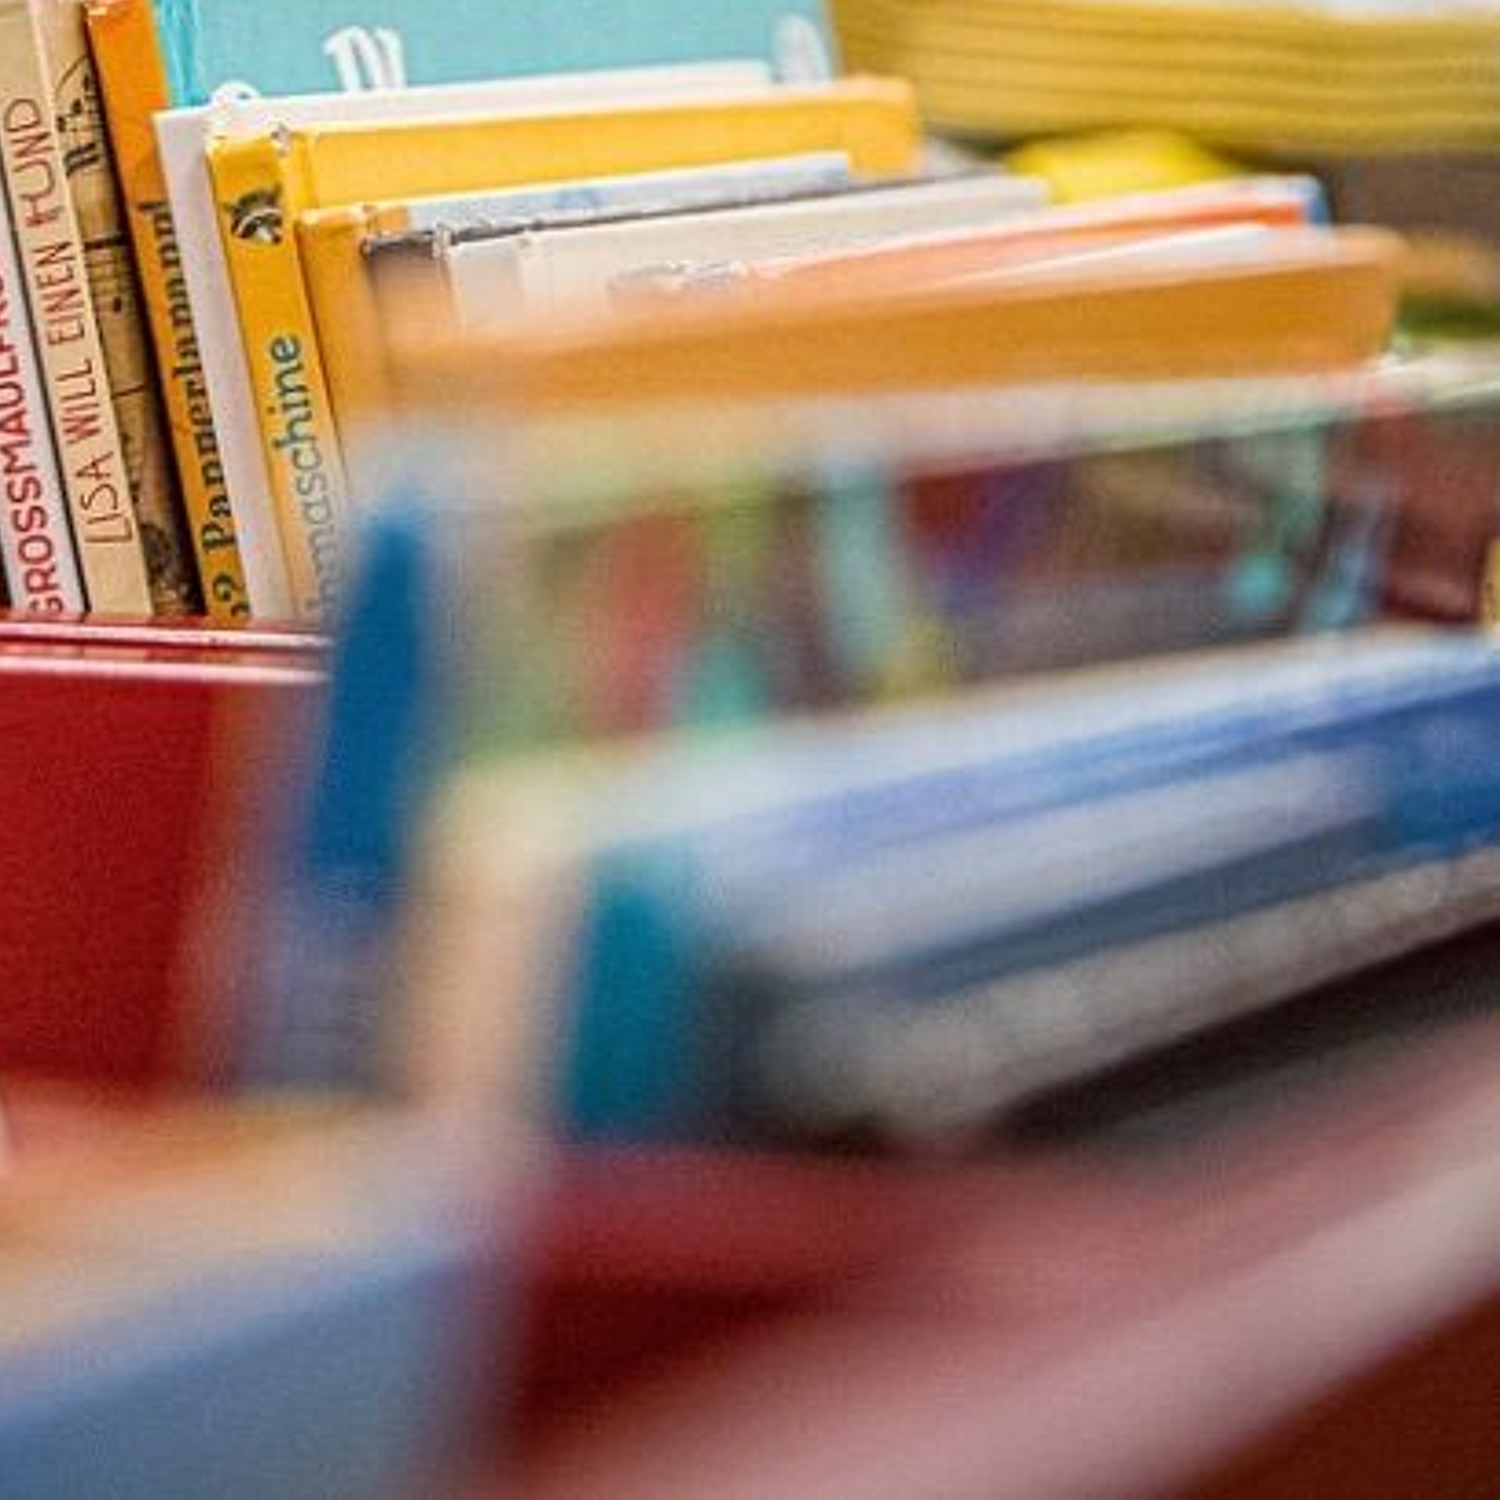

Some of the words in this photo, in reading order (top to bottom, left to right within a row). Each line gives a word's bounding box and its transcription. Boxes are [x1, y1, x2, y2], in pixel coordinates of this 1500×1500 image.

[3, 97, 68, 228] HUND
[32, 241, 86, 346] EINEN
[55, 358, 103, 446] WILL
[75, 451, 134, 544] LISA
